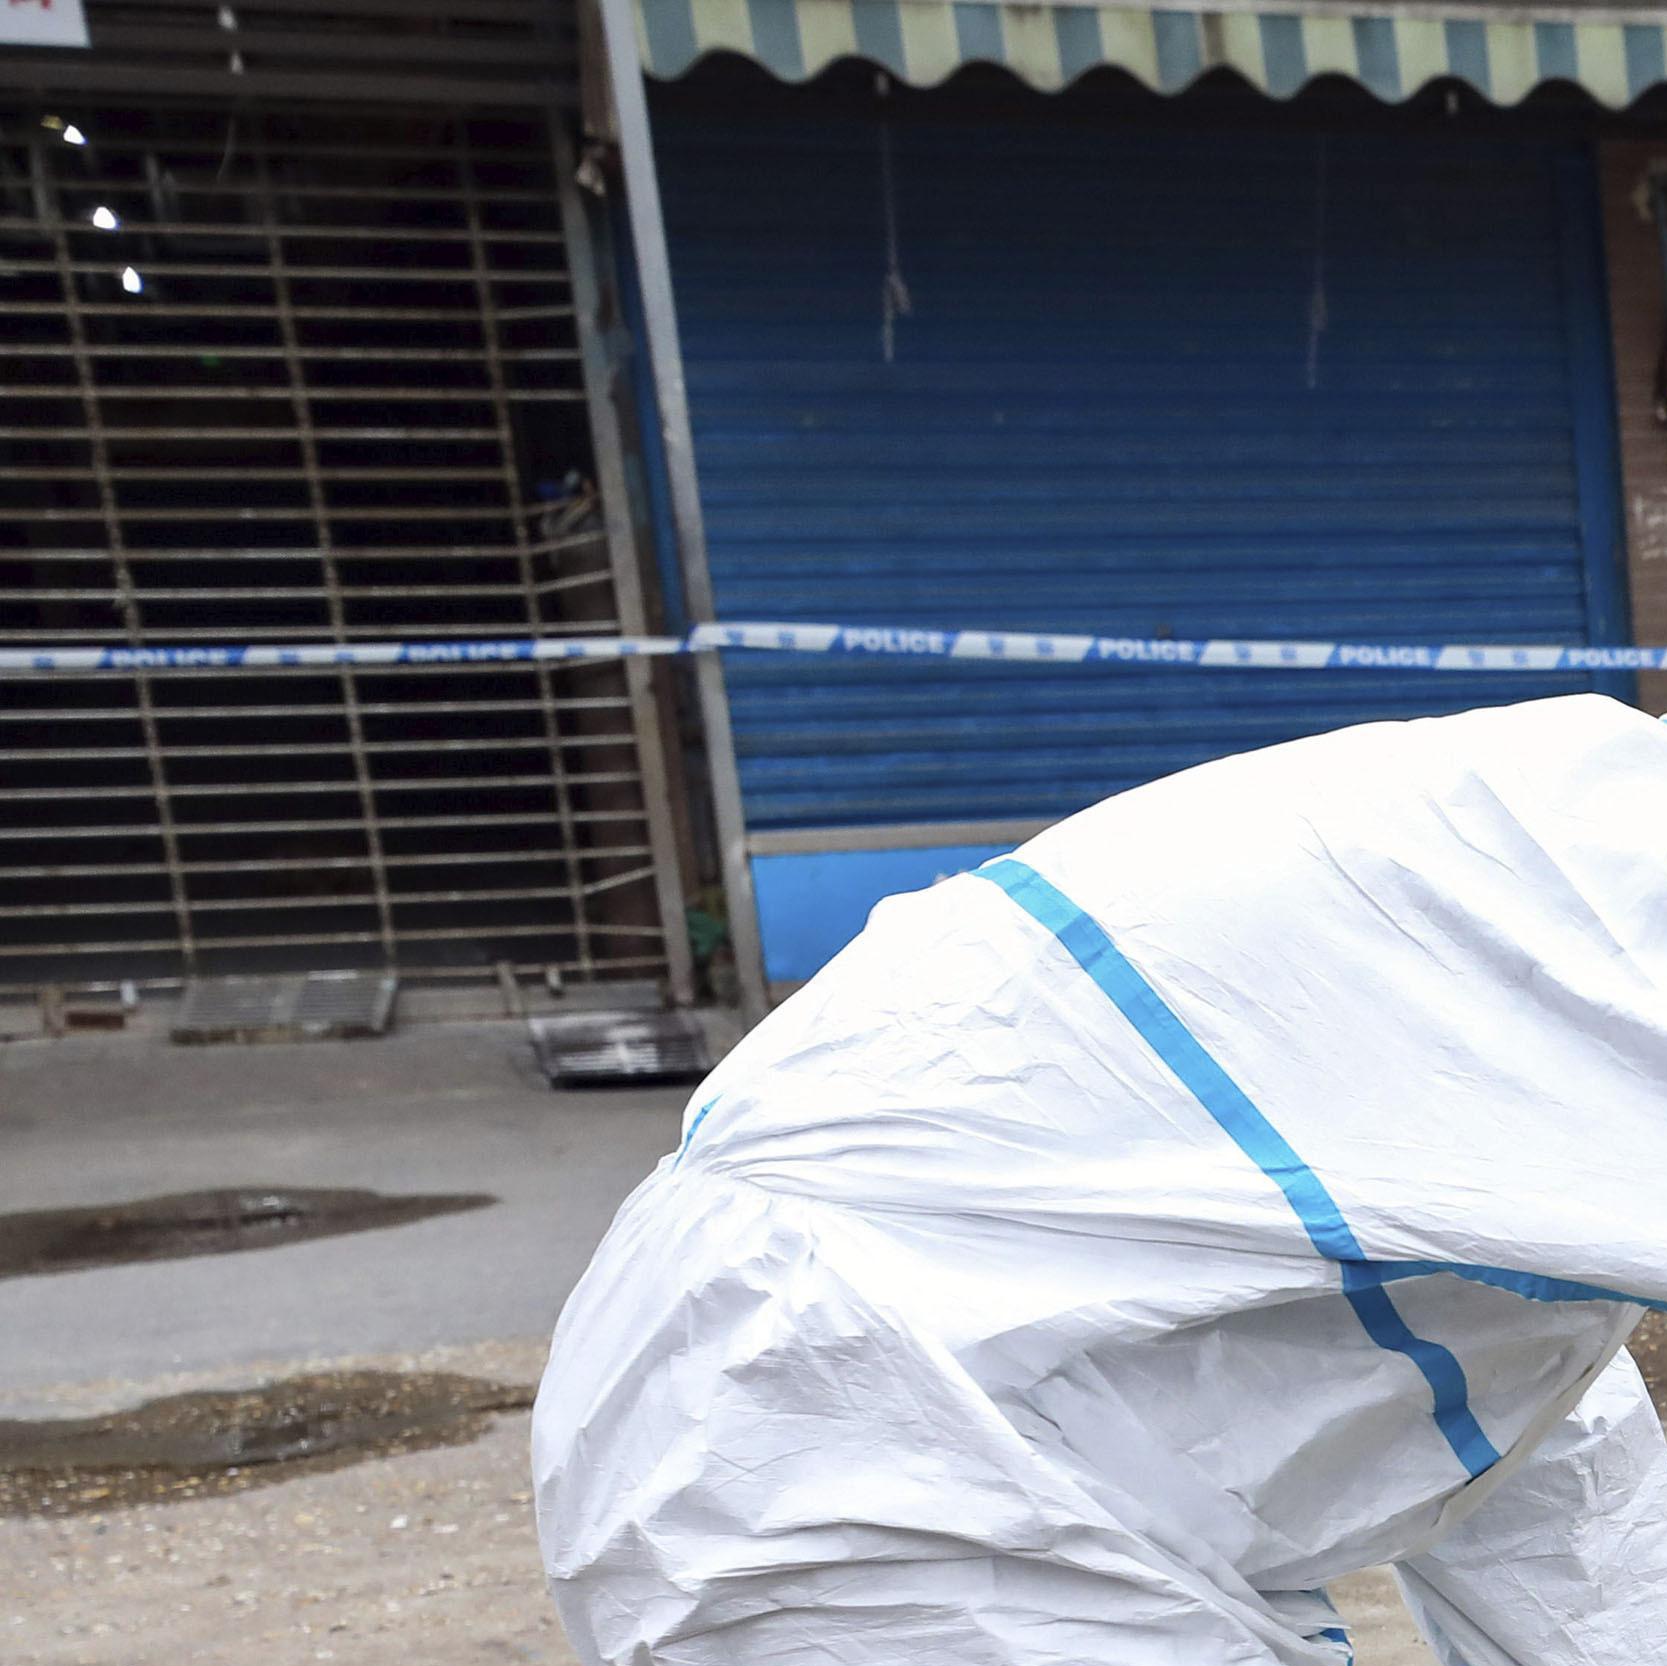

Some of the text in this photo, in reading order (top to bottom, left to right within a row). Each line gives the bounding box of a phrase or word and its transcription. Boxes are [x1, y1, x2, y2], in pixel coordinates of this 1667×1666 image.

[843, 629, 944, 653] POLICE
[1098, 638, 1194, 661] POLICE
[1340, 645, 1430, 666] POLICE
[1568, 648, 1653, 667] POLICE
